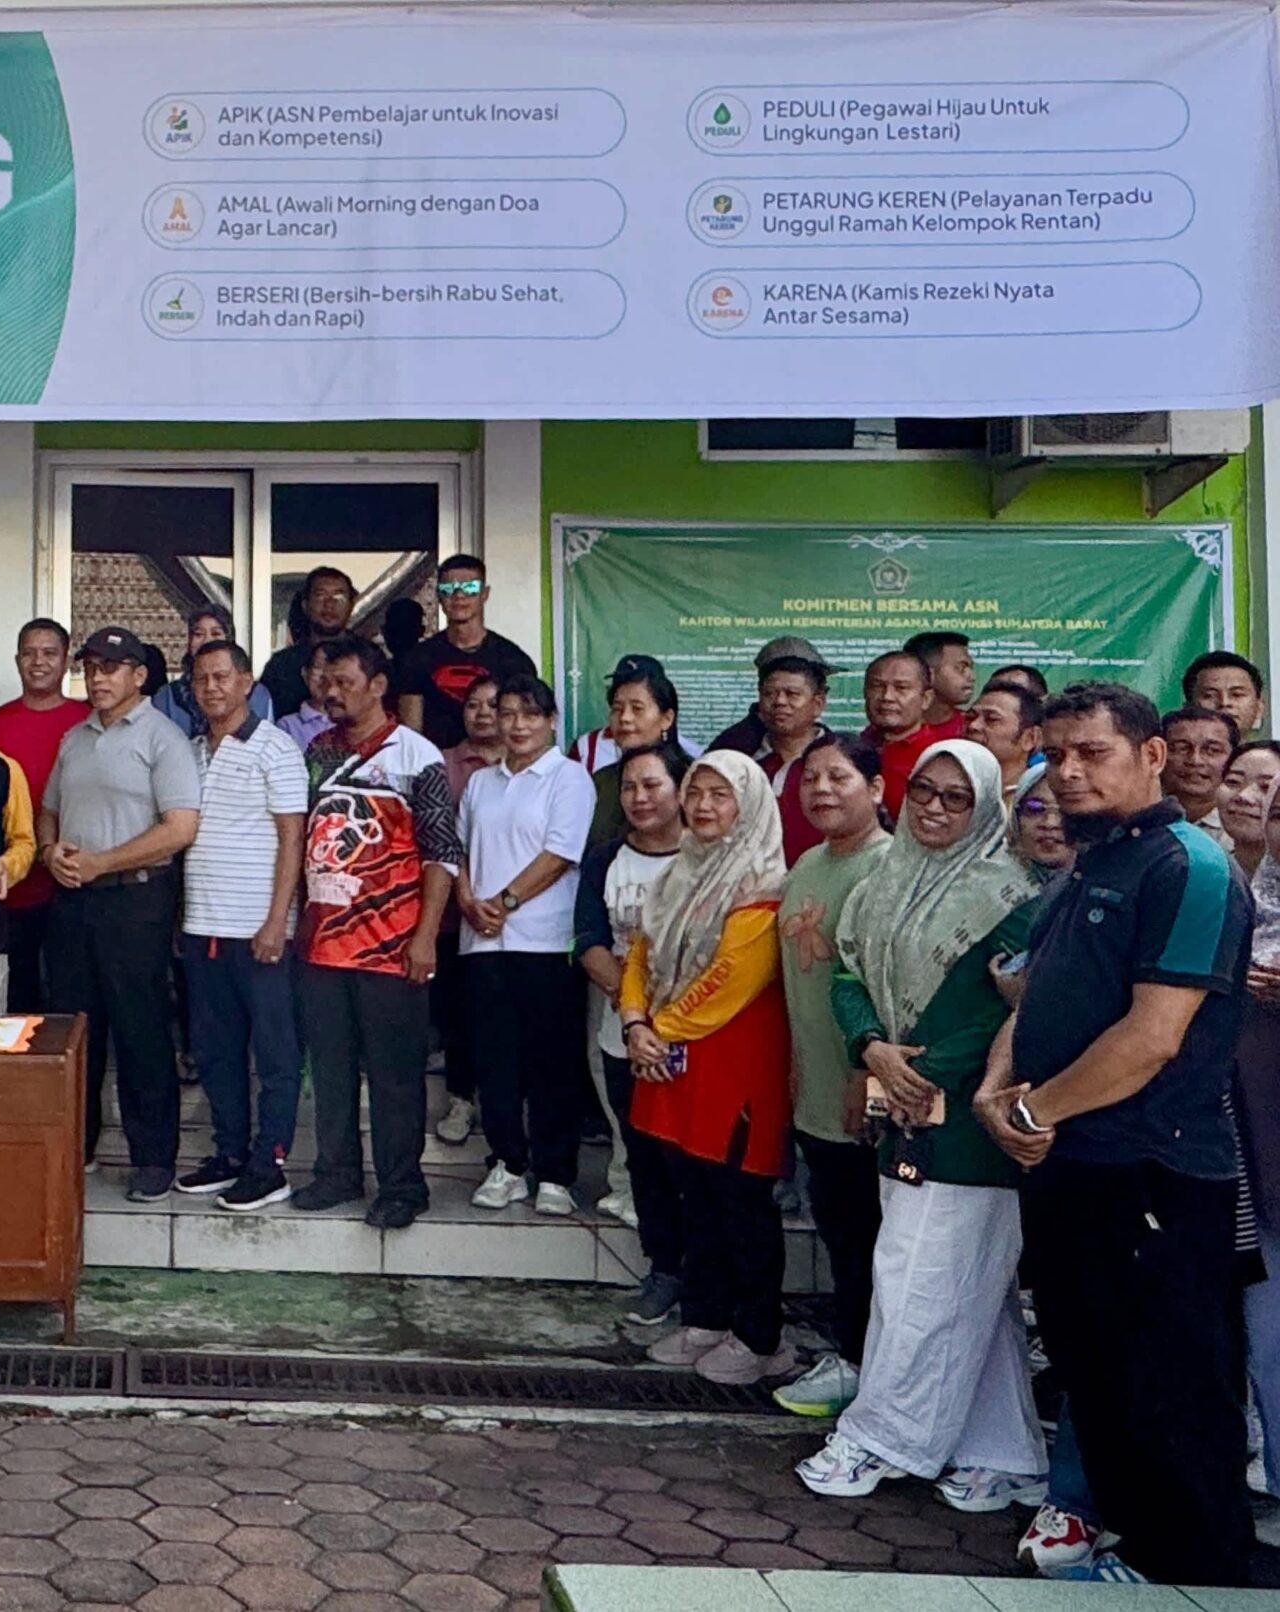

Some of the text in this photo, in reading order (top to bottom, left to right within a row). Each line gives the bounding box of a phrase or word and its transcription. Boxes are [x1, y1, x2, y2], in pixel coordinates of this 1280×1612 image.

[218, 104, 558, 126] APIK (ASN Pembelajar untuk Inovasi
[764, 97, 1049, 121] PEDULI (Pegawai Hijau Untuk
[166, 133, 193, 143] APIK
[218, 129, 382, 149] dan Kompetensi)
[705, 126, 741, 137] PEDULI
[764, 123, 960, 145] Lingkungan Lestari)
[218, 194, 539, 216] AMAL (Awali Morning dengan Doa
[764, 188, 1152, 211] PETARUNG KEREN (Pelayanan Terpadu
[162, 222, 192, 232] AMAL
[218, 219, 337, 240] Agar Lancar)
[764, 212, 1100, 236] Unggul Ramah Kelompok Rentan)
[218, 287, 299, 303] BERSERI
[304, 285, 442, 306] (Bersih-bersih
[447, 284, 496, 301] Rabu
[764, 282, 1054, 303] KARENA (Kamis Rezeki Nyata
[158, 312, 195, 321] BERSERI
[217, 309, 364, 329] Indah dan Rapi)
[764, 307, 908, 326] Antar Sesama)
[783, 598, 999, 612] KOMITMEN BERSAMA ASN
[679, 615, 1108, 629] KANTOR WILAYAH KEMENTERIAN AGAMA PROVINSI SUMATERA BARAT
